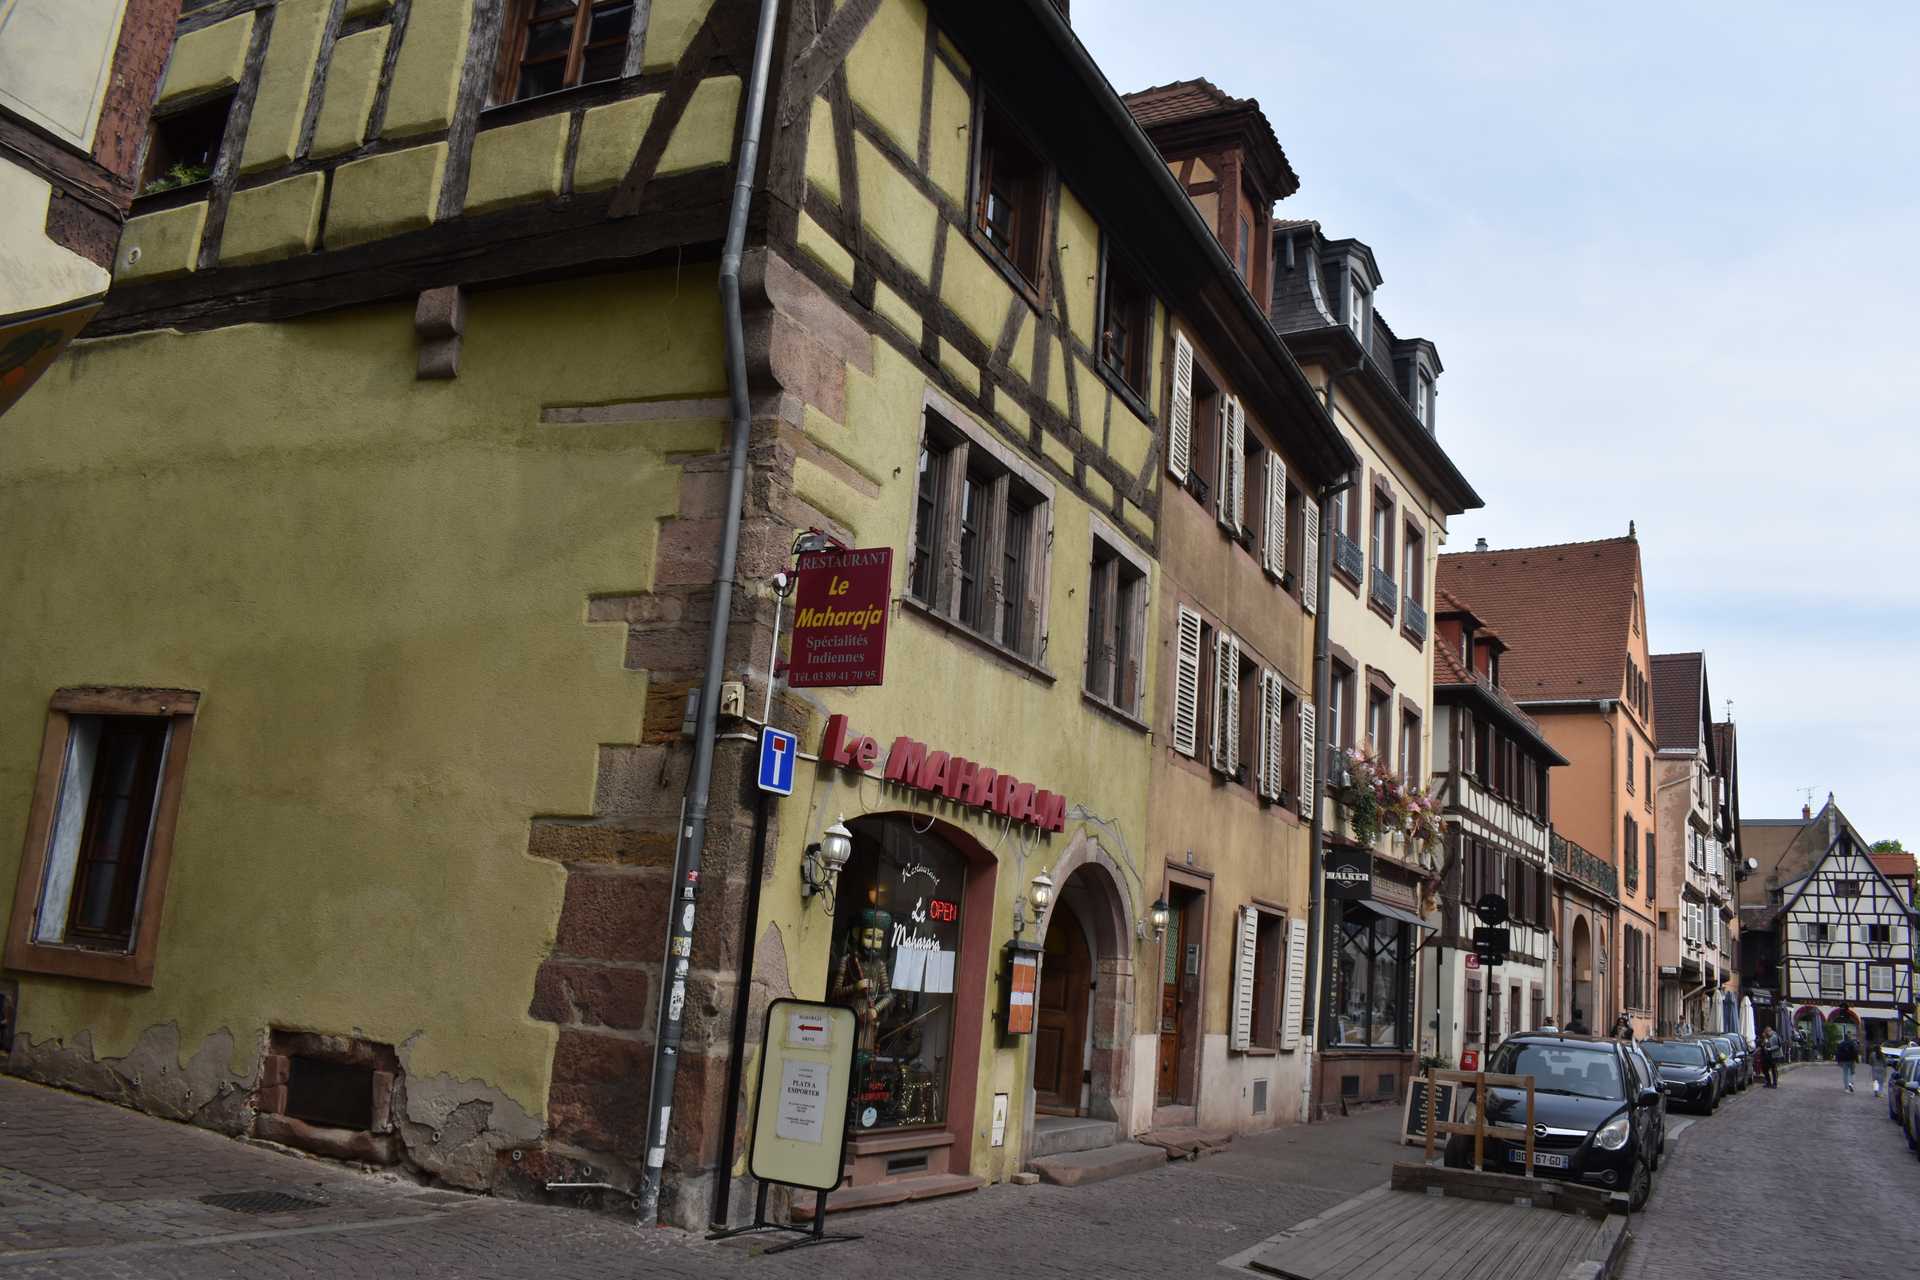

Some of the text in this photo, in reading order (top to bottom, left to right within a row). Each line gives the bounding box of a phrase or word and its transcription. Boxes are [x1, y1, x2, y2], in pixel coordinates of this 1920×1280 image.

[802, 551, 888, 570] RESTAURANT
[828, 575, 849, 596] Le
[795, 604, 883, 631] Maharaja
[806, 634, 868, 651] Spécialités
[807, 652, 865, 664] Indiennes
[823, 714, 1067, 834] Le MAHARAJA
[911, 896, 926, 923] Le
[930, 900, 957, 921] OPEN
[891, 921, 941, 952] Maharaja
